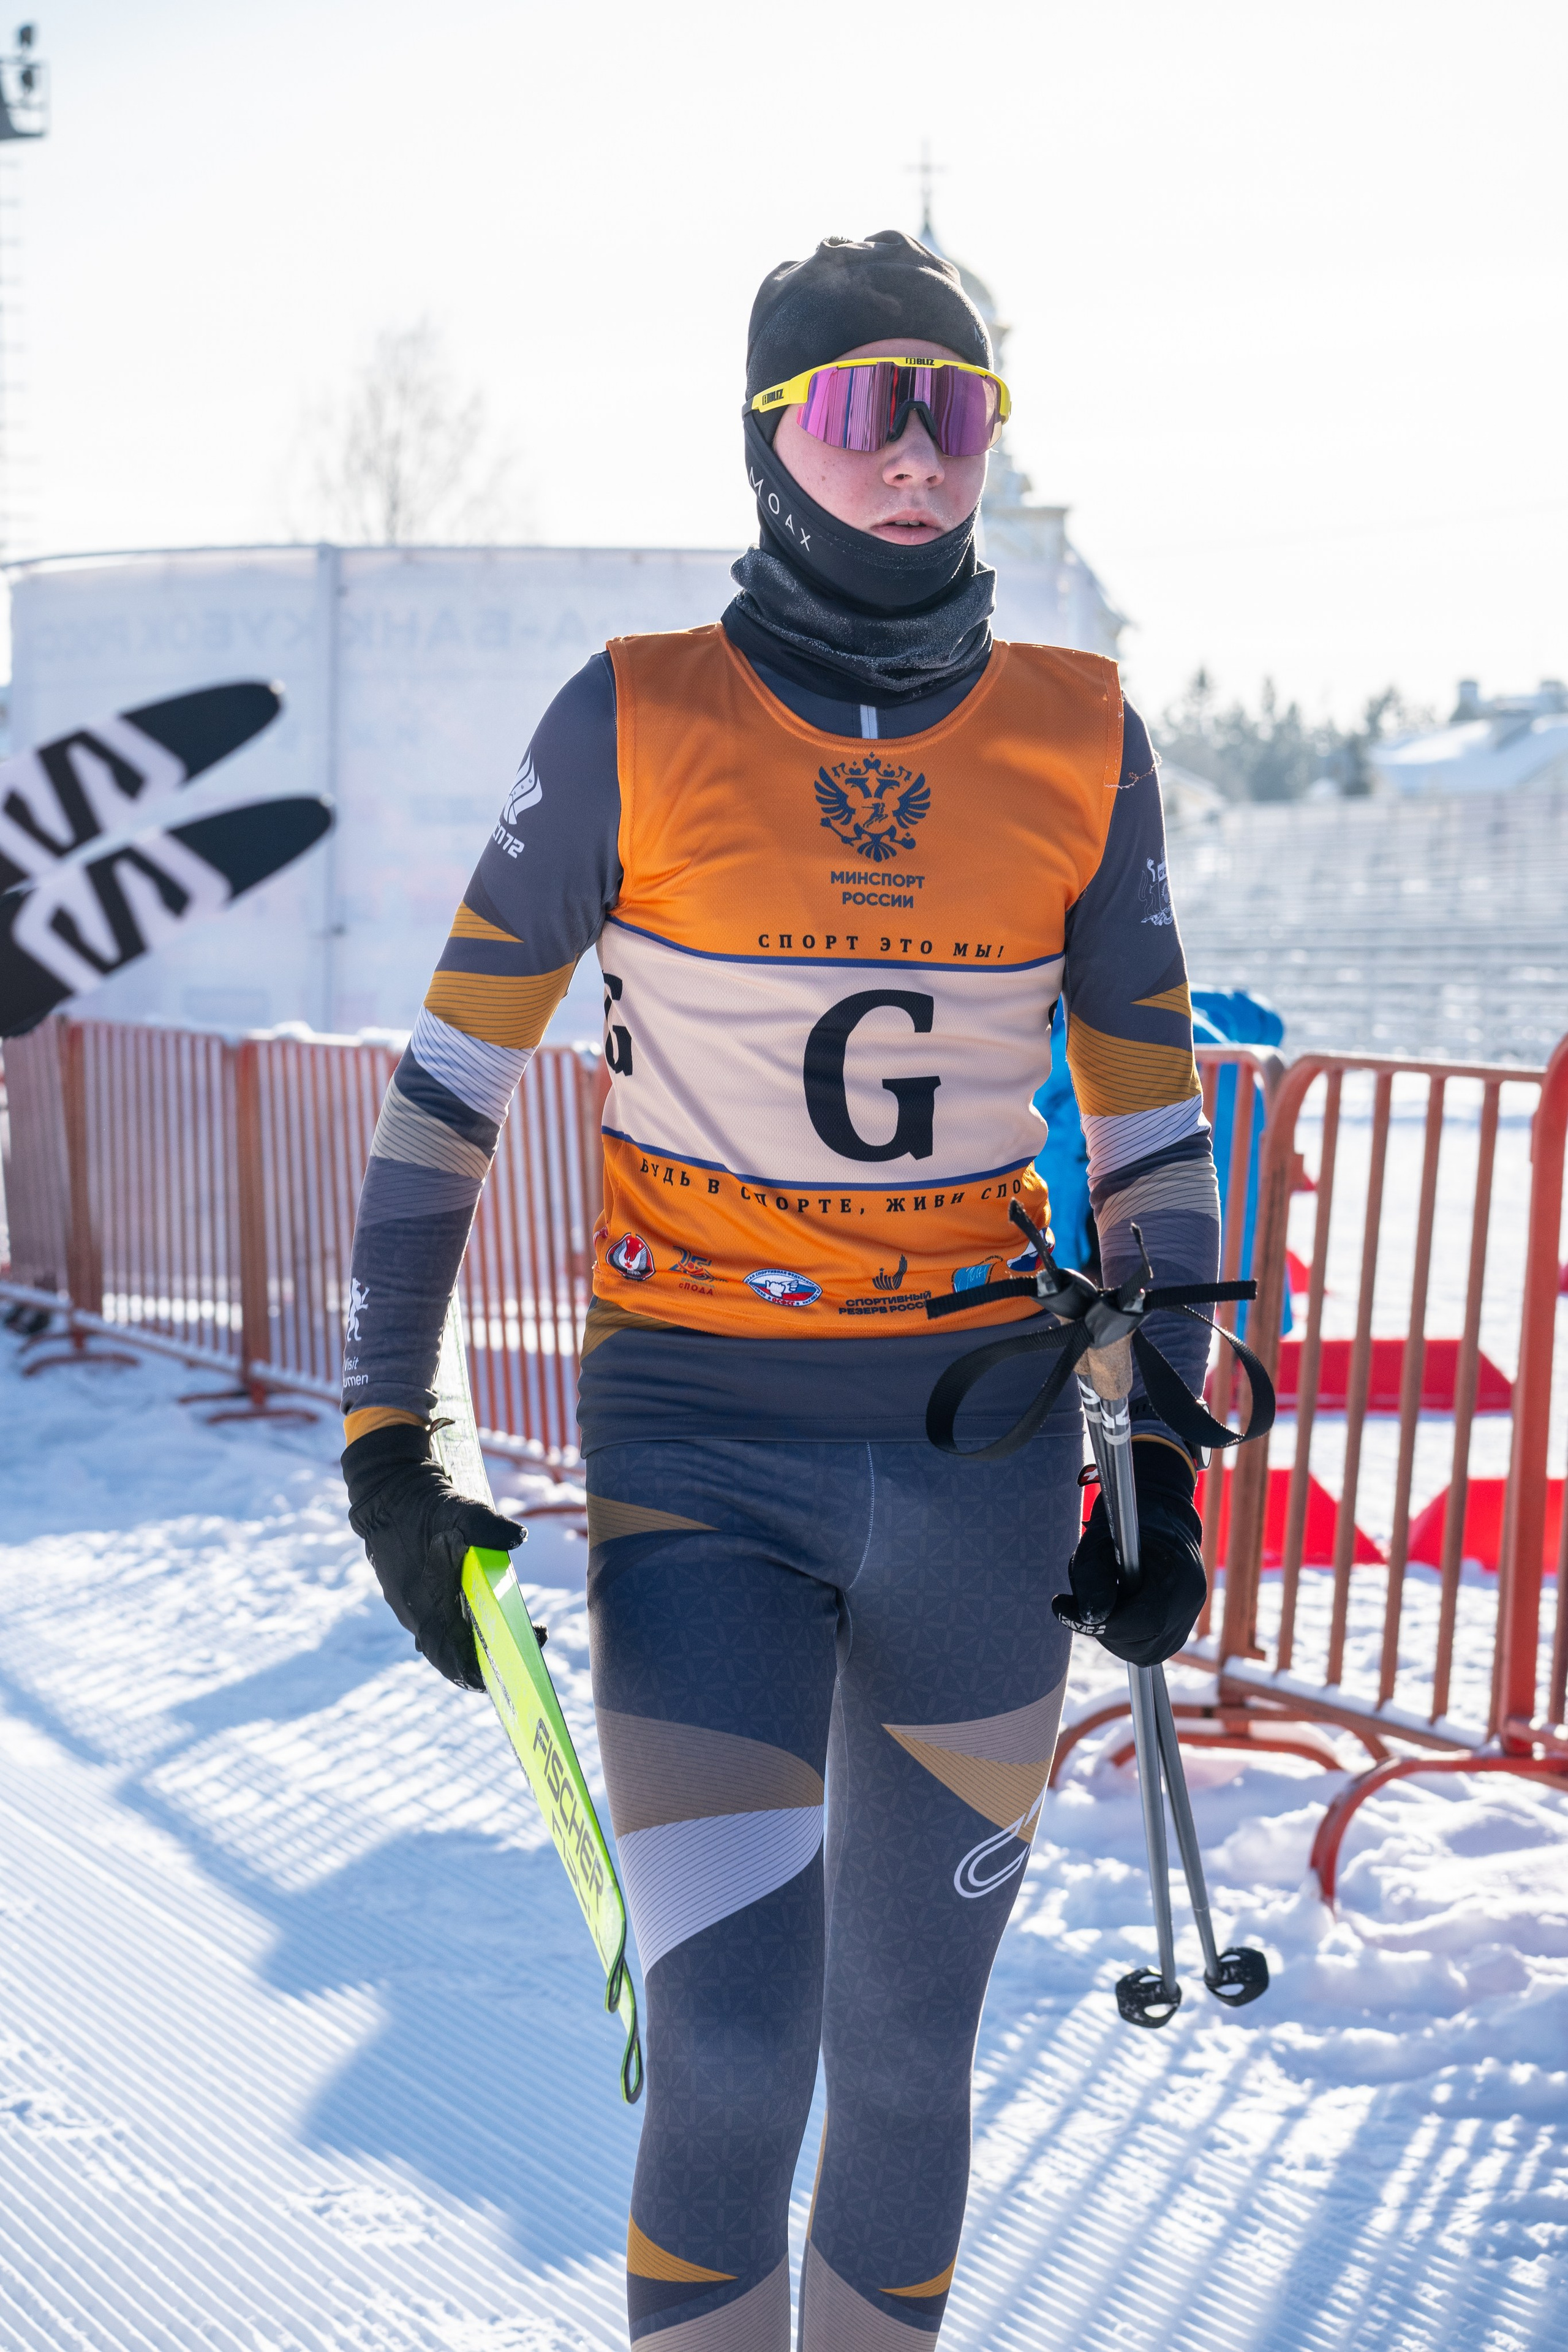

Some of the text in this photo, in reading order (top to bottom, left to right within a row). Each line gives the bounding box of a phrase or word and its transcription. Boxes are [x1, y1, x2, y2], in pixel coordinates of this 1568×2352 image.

[749, 466, 812, 552] MOAX
[830, 870, 925, 889] МИНСПОРТ
[842, 891, 914, 909] РОССИИ
[758, 934, 1005, 958] СПОРТ ЭТО МЫ!
[802, 988, 942, 1163] G
[640, 1158, 1028, 1215] БУДЬ В СПОРТЕ, ЖИВИ СПО
[845, 1290, 932, 1307] СПОРТИВНЫЙ
[838, 1306, 888, 1315] РЕЗЕРВ
[343, 1373, 369, 1389] umen
[532, 1717, 604, 1915] FISCHER
